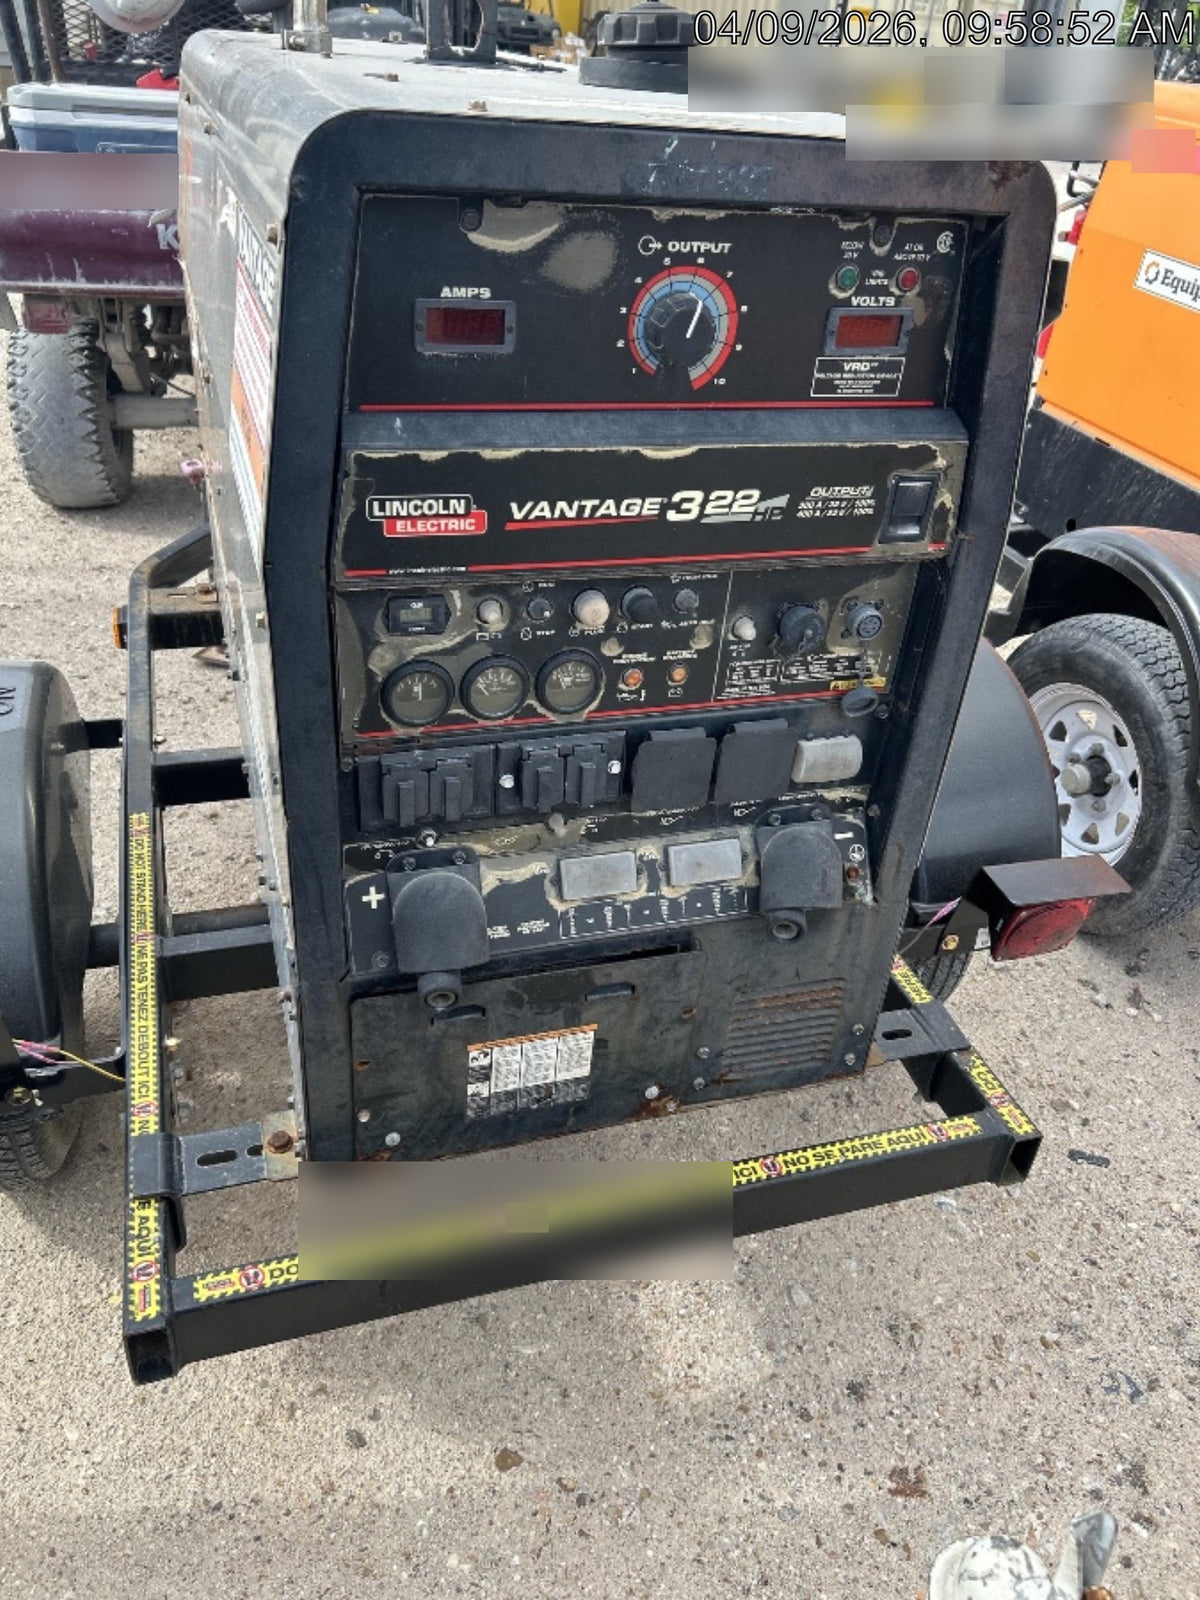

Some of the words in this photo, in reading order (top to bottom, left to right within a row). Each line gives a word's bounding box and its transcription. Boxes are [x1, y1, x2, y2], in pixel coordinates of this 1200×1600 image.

[668, 241, 732, 254] OUTPUT
[663, 257, 671, 265] 5
[440, 286, 492, 299] AMPS
[851, 296, 896, 307] VOLTS
[631, 367, 636, 375] 1
[843, 362, 871, 371] VRD
[810, 486, 870, 497] OUTPUT
[373, 500, 467, 517] LINCOLN
[510, 498, 661, 520] VANTAGE
[666, 489, 762, 522] 322
[396, 518, 476, 532] ELECTRIC
[136, 873, 147, 903] STAND
[138, 985, 149, 1021] TENEZ
[138, 1026, 149, 1076] DEBOUT
[138, 1081, 149, 1098] ICI
[783, 1154, 809, 1169] NO
[812, 1149, 839, 1163] SE
[841, 1140, 883, 1158] PARE
[733, 1166, 758, 1180] ICI
